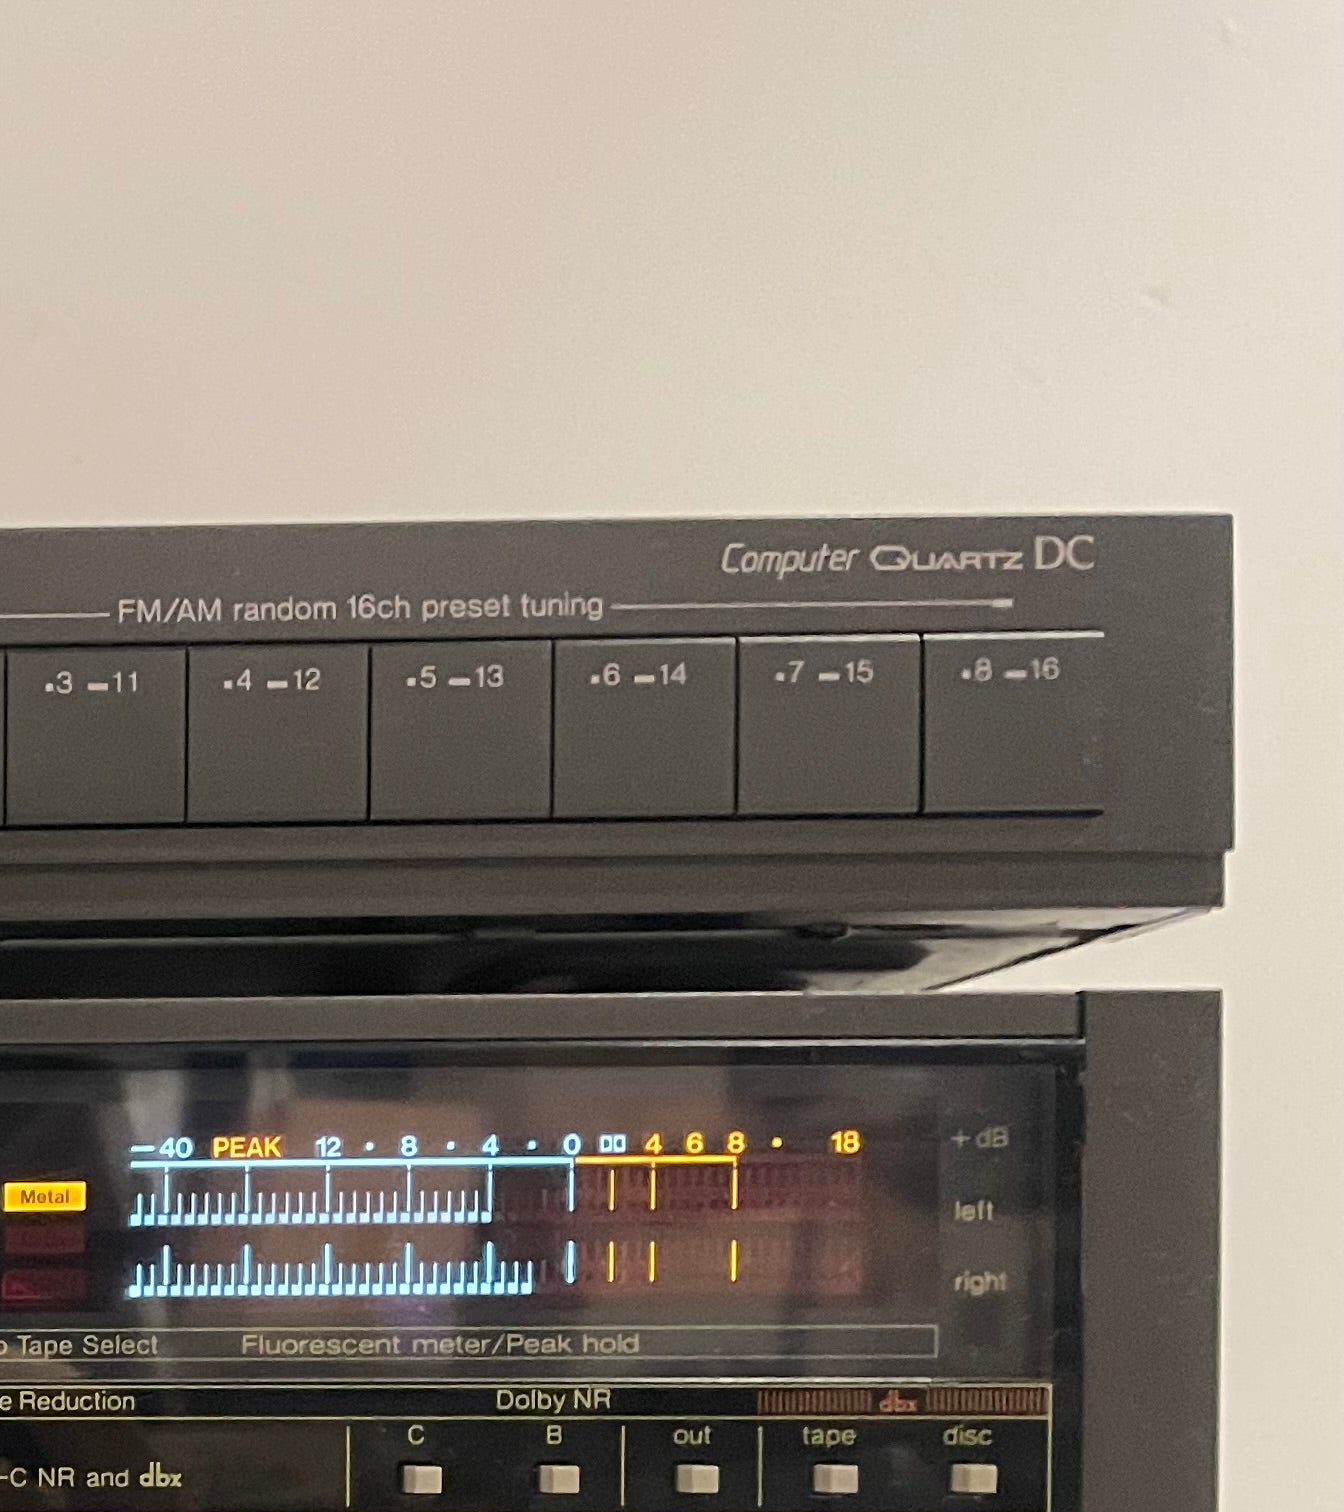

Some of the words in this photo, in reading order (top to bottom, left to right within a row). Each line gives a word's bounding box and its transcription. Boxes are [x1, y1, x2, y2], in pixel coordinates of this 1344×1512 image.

[721, 542, 860, 580] Computer
[1034, 534, 1094, 571] DC
[118, 598, 222, 624] FM/AM
[233, 596, 337, 622] random
[348, 594, 410, 620] 16ch
[422, 594, 510, 622] preset
[520, 592, 603, 622] tuning
[212, 1136, 282, 1158] PEAK
[315, 1136, 342, 1158] 12
[830, 1130, 860, 1154] 18
[20, 1189, 70, 1204] Metal
[955, 1200, 994, 1222] left
[954, 1270, 1008, 1296] right
[16, 1336, 73, 1358] Tape
[82, 1334, 159, 1356] Select
[241, 1334, 400, 1355] Fluorescent
[412, 1333, 573, 1355] meter/Peak
[582, 1333, 640, 1354] hold
[19, 1390, 136, 1412] Reduction
[496, 1388, 566, 1413] Dolby
[573, 1388, 612, 1410] NR
[674, 1426, 712, 1446] out
[802, 1426, 856, 1448] tape
[942, 1424, 992, 1446] disc
[38, 1466, 74, 1488] NR
[86, 1468, 130, 1488] and
[140, 1462, 182, 1488] dbx
